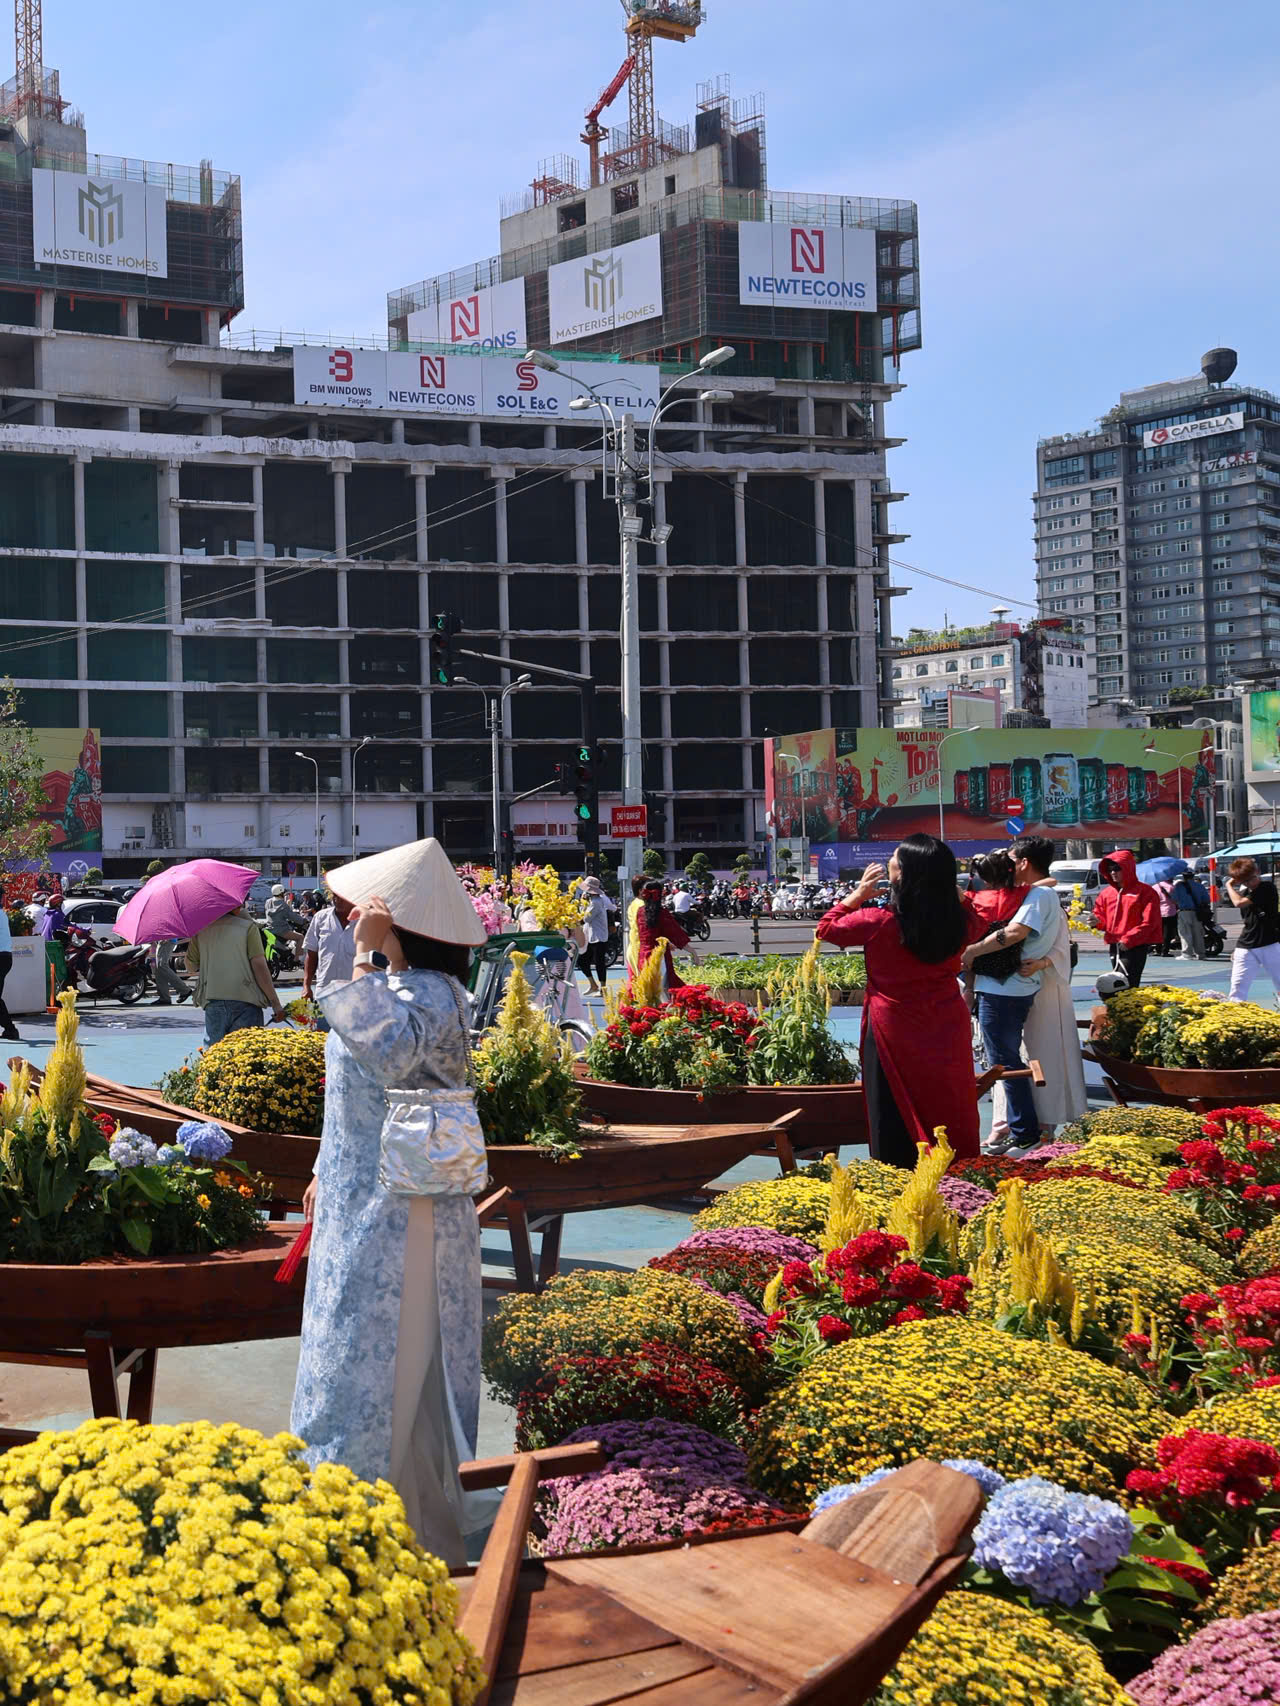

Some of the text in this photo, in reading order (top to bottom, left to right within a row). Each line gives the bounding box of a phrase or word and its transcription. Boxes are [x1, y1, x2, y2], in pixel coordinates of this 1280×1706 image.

[43, 247, 159, 272] MASTERISE HOMES
[748, 276, 866, 299] NEWTECONS
[556, 304, 656, 340] MASTERISE HOMES
[310, 384, 372, 396] BM WINDOWS
[347, 397, 372, 405] Façade
[389, 391, 476, 407] NEWTECONS
[497, 395, 558, 410] SOL E&C
[1172, 417, 1233, 436] CAPELLA
